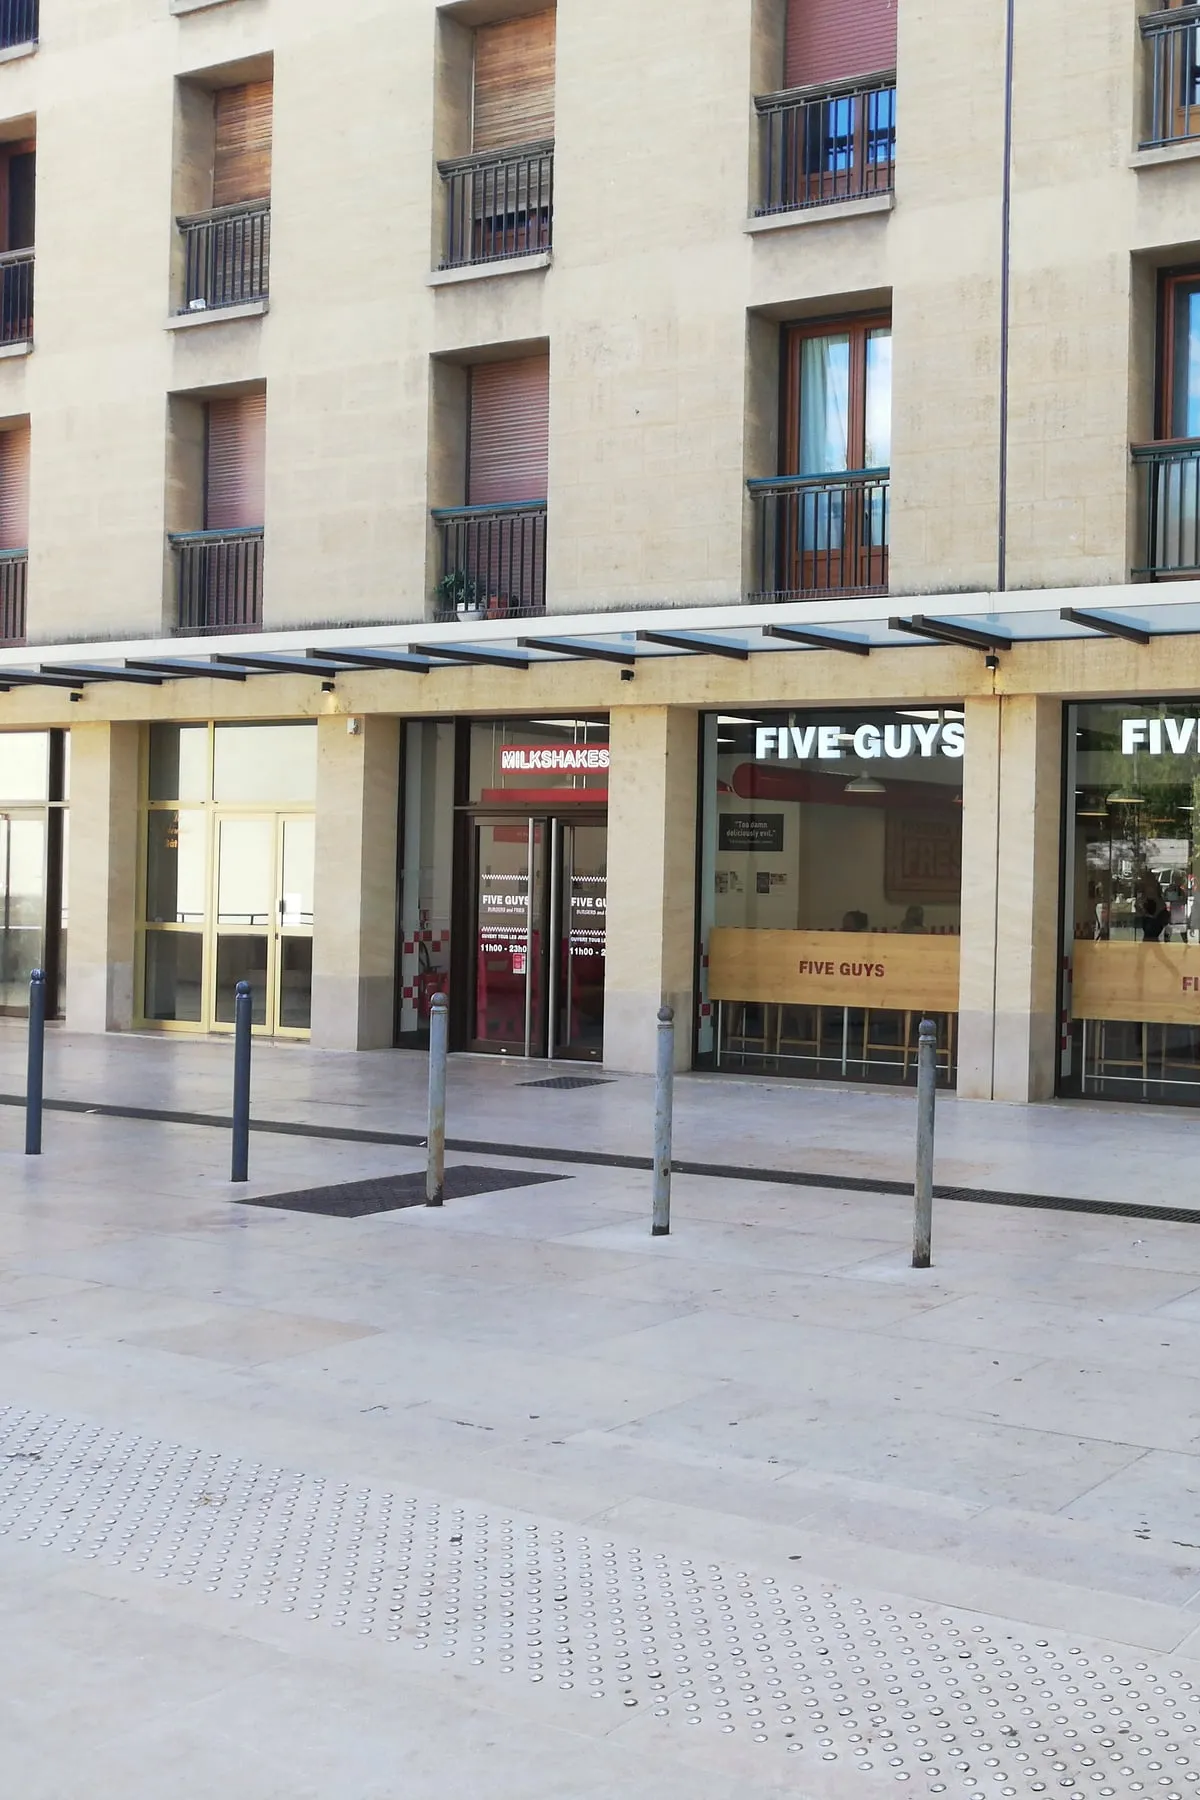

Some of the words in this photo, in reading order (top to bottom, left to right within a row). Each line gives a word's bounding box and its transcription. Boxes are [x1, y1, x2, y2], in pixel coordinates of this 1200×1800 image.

[755, 726, 841, 760] FIVE
[853, 722, 965, 759] GUYS
[501, 749, 610, 769] MILKSHAKES
[482, 895, 503, 905] FIVE
[504, 895, 529, 906] GUYS
[570, 897, 593, 907] FIVE
[480, 944, 503, 952] 11h00
[569, 946, 594, 956] 11h00
[799, 960, 835, 975] FIVE
[839, 962, 885, 977] GUYS
